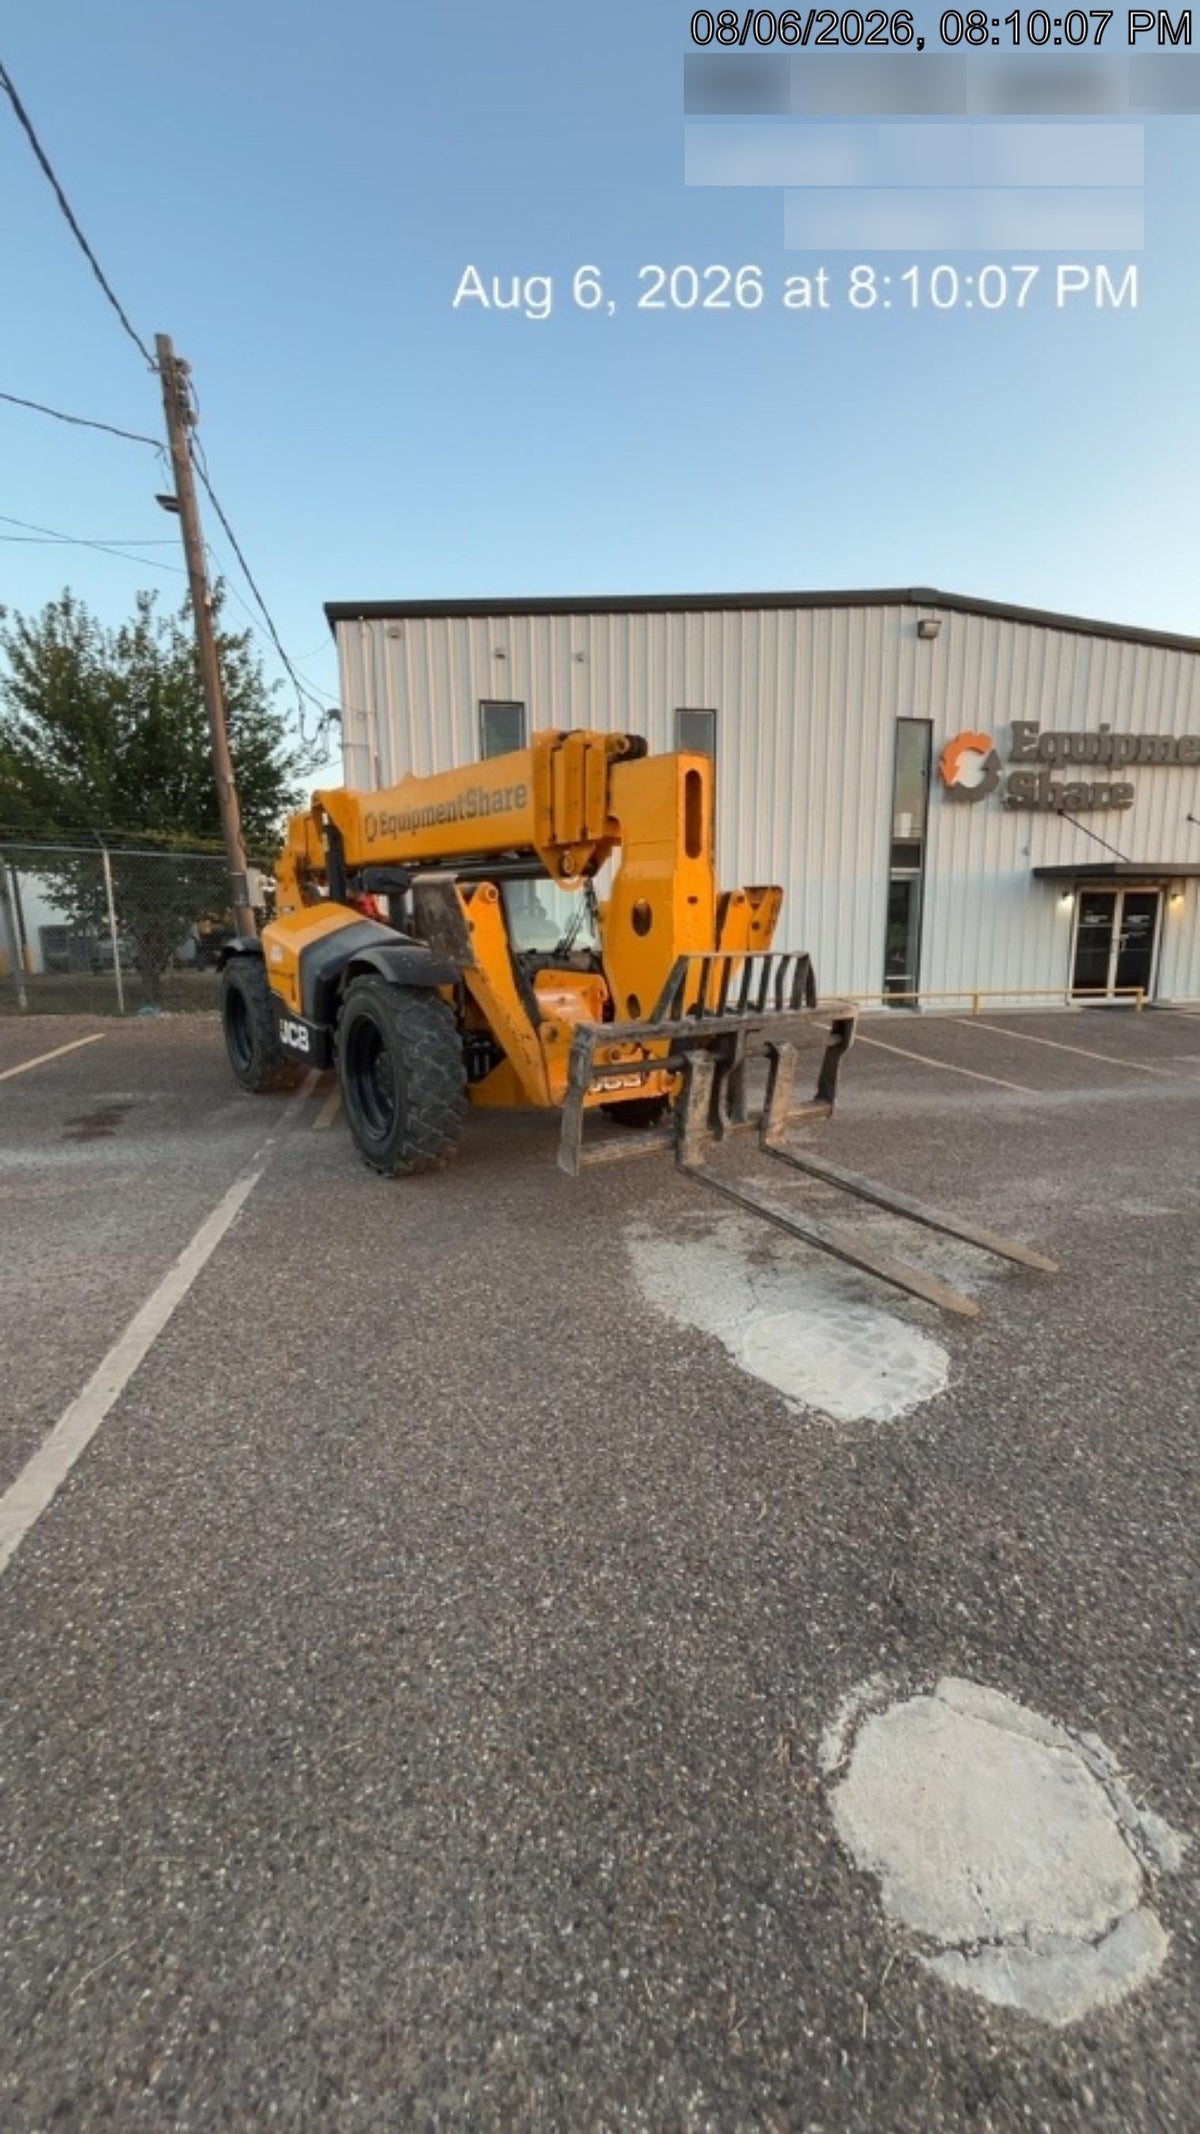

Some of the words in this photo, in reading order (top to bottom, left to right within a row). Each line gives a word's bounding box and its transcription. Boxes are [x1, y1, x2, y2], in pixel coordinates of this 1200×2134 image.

[380, 784, 528, 840] EquipmentShare
[1004, 770, 1135, 812] Share
[279, 1019, 309, 1052] JCB
